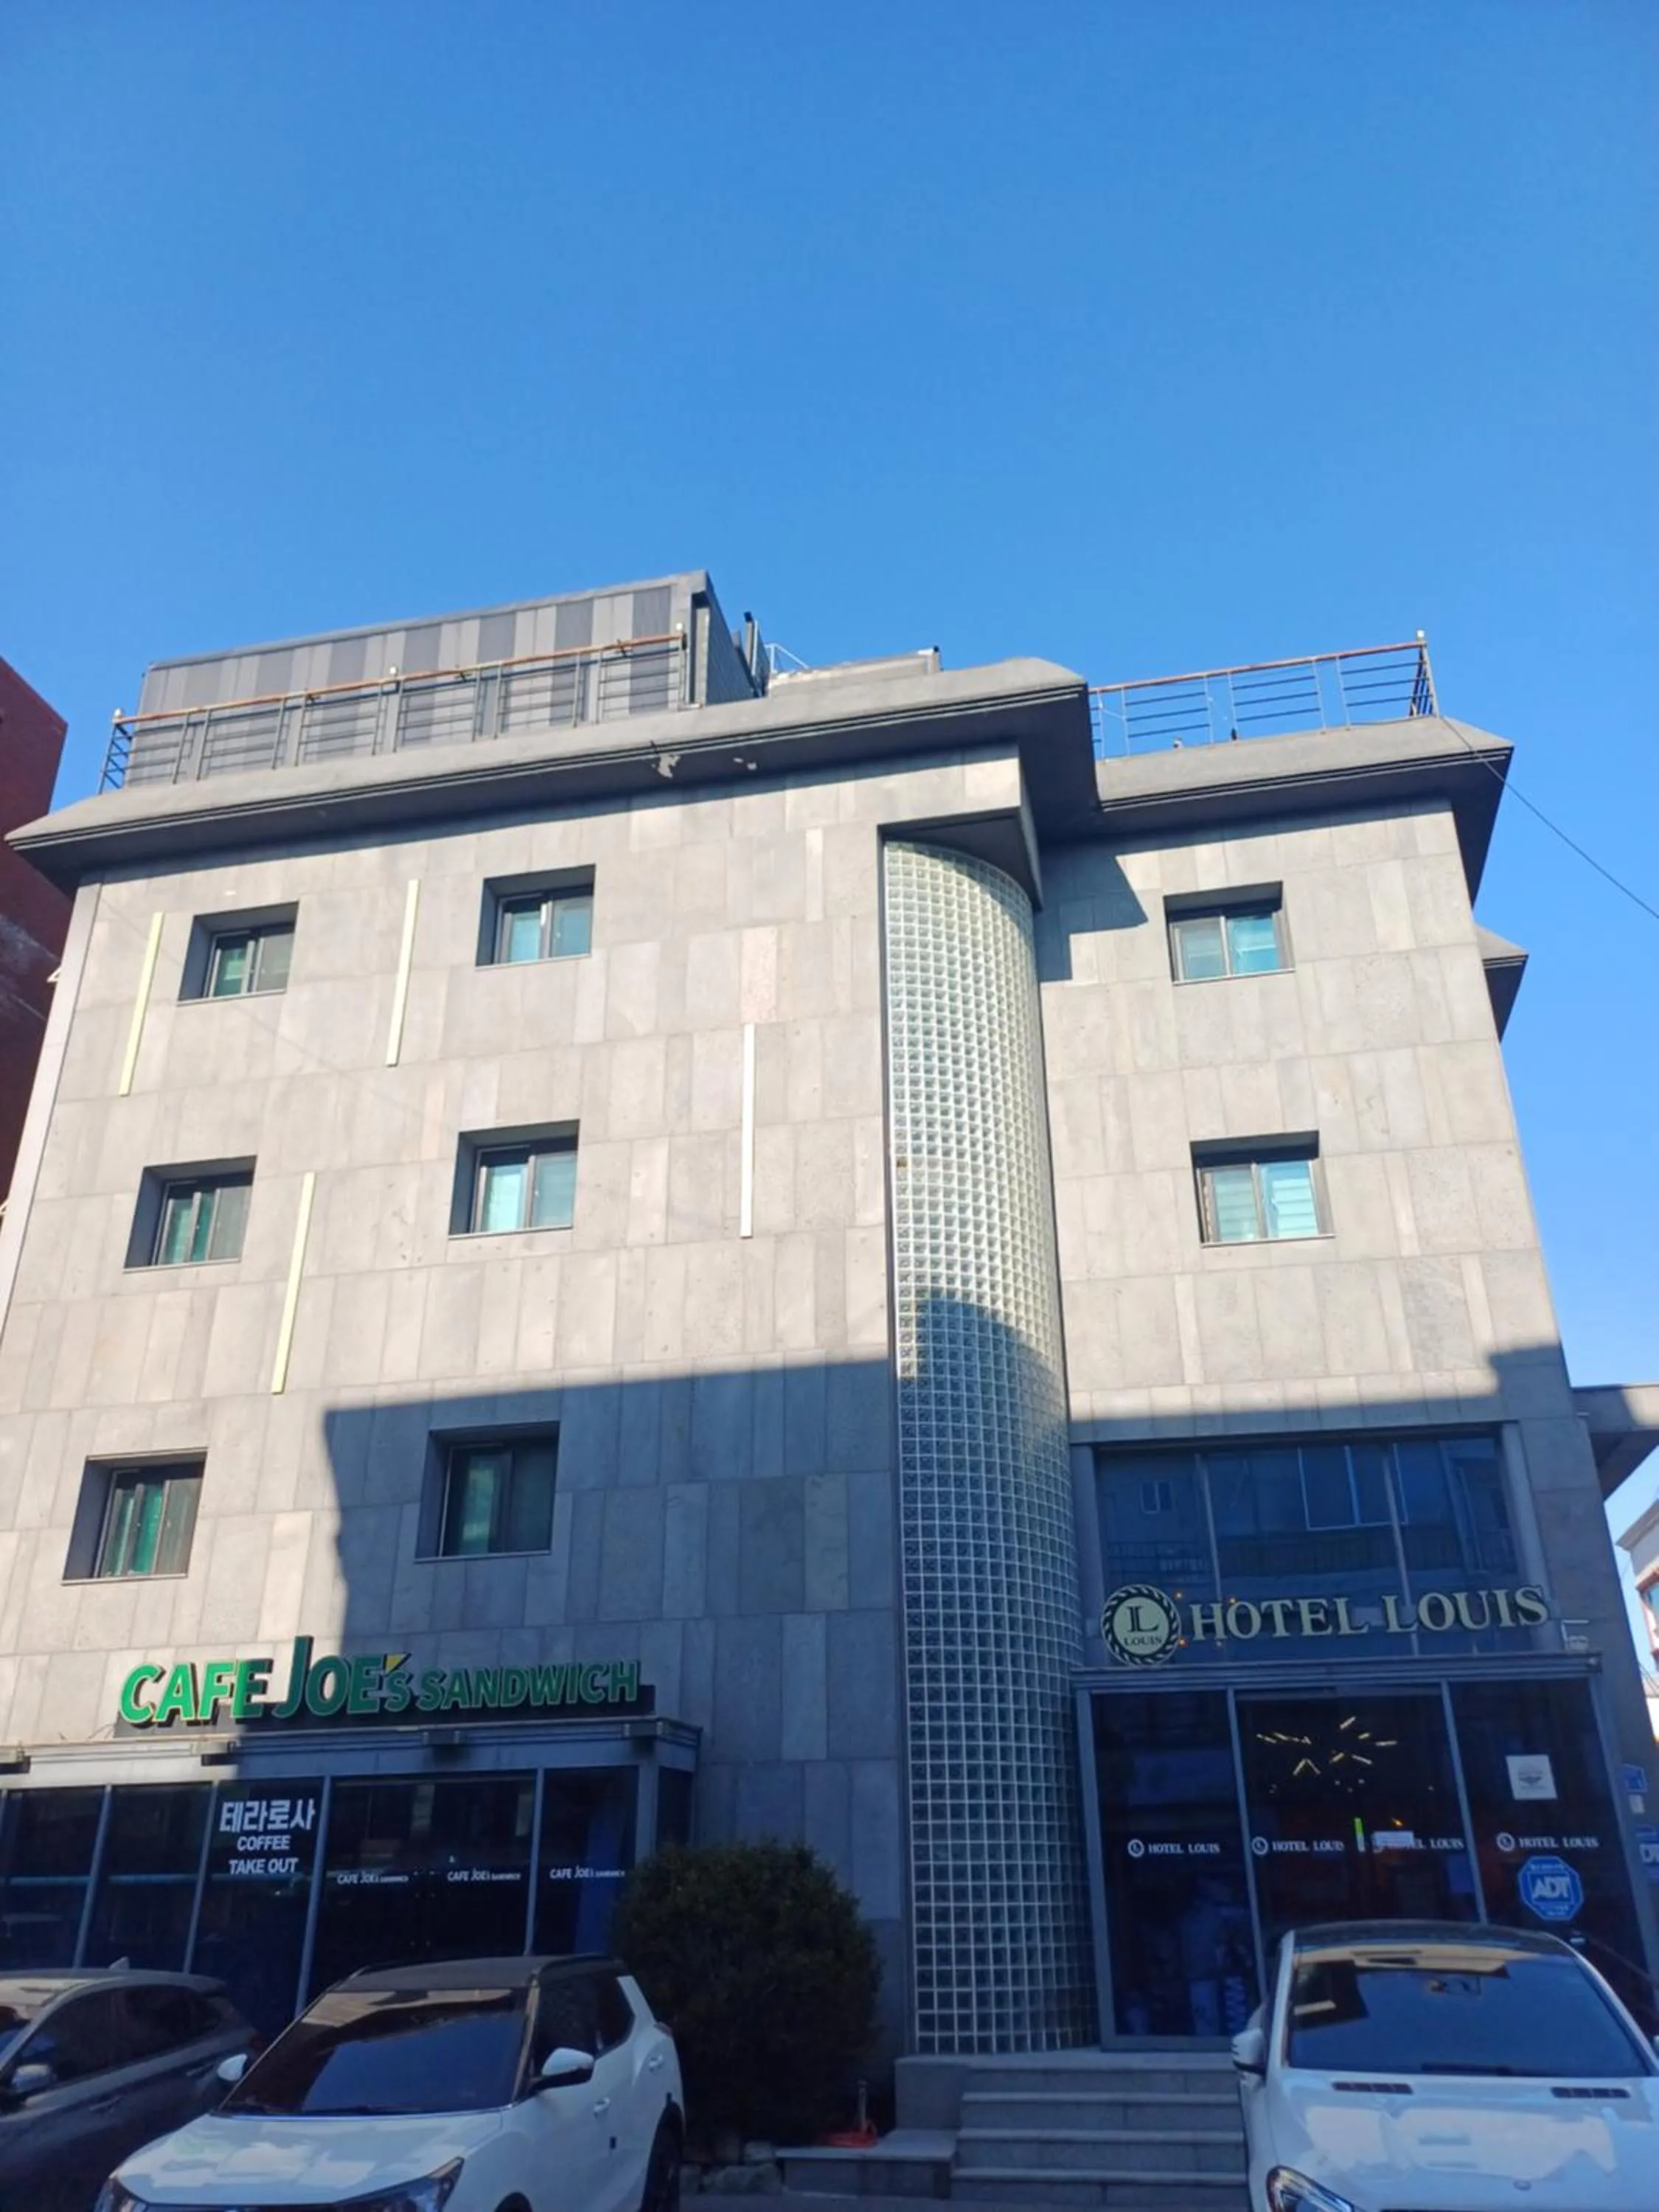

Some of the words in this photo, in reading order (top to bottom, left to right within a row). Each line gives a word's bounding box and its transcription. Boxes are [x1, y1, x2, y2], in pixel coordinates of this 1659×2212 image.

[1189, 1597, 1369, 1642] HOTEL
[1381, 1586, 1548, 1633] LOUIS
[1124, 1635, 1163, 1646] LOUIS
[120, 1658, 274, 1728] CAFE
[415, 1660, 641, 1712] SANDWICH
[219, 1798, 316, 1833] 테라로사
[237, 1834, 291, 1851] COFFEE
[1147, 1842, 1185, 1853] HOTEL
[1272, 1840, 1310, 1852] HOTEL
[1518, 1836, 1559, 1848] HOTEL
[229, 1857, 266, 1875] TAKE
[267, 1857, 299, 1874] OUT
[549, 1867, 572, 1879] CAFE
[447, 1870, 470, 1882] CAFE
[1532, 1875, 1571, 1899] ADT
